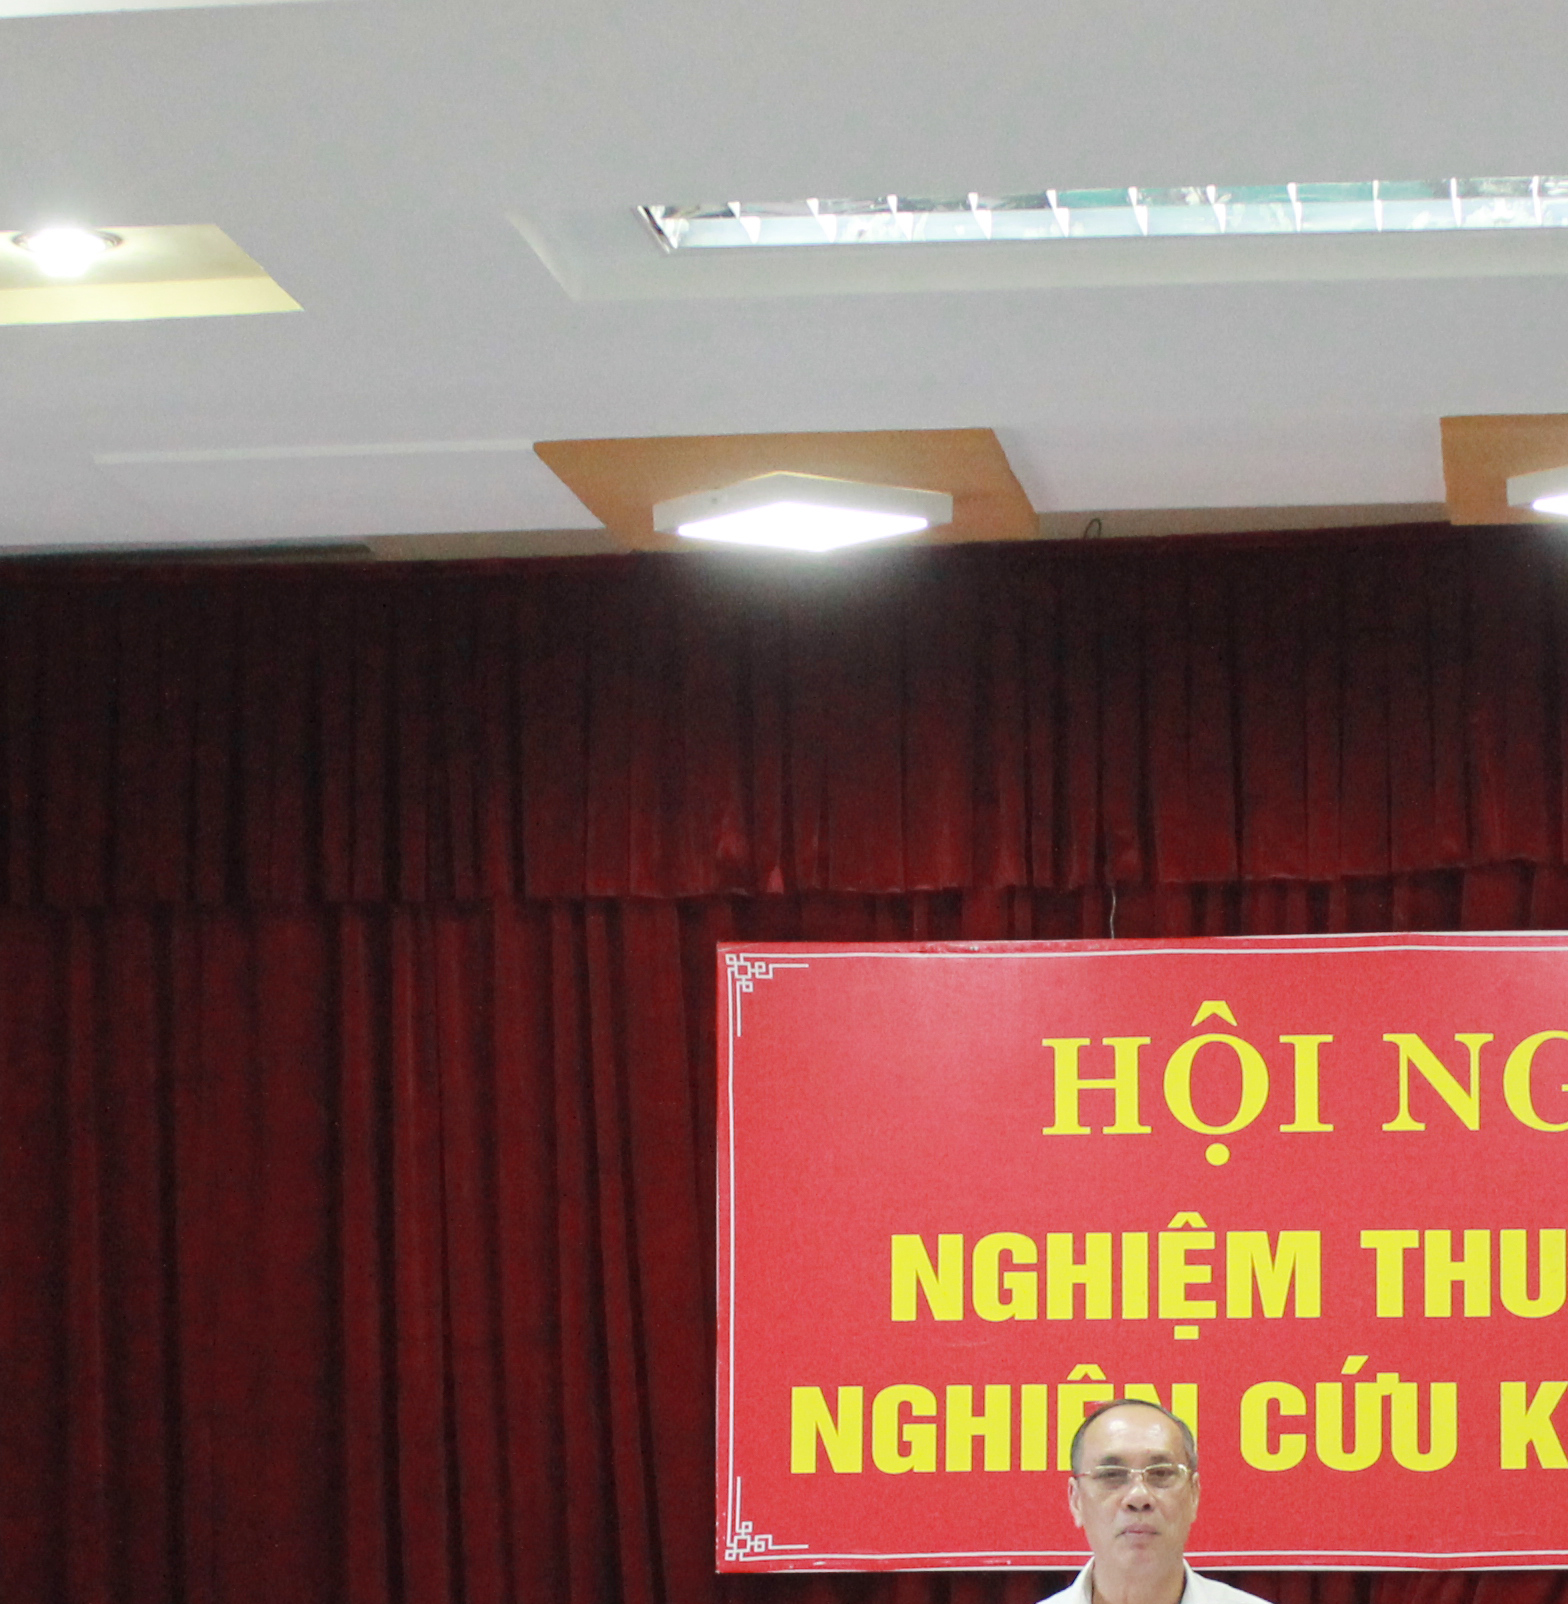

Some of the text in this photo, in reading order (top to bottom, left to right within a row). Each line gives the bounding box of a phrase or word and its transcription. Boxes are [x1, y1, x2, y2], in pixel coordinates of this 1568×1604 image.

[1041, 1000, 1335, 1166] HỘI
[890, 1211, 1322, 1340] NGHIỆM
[1359, 1229, 1567, 1318] THU
[1239, 1355, 1458, 1473] CỨU
